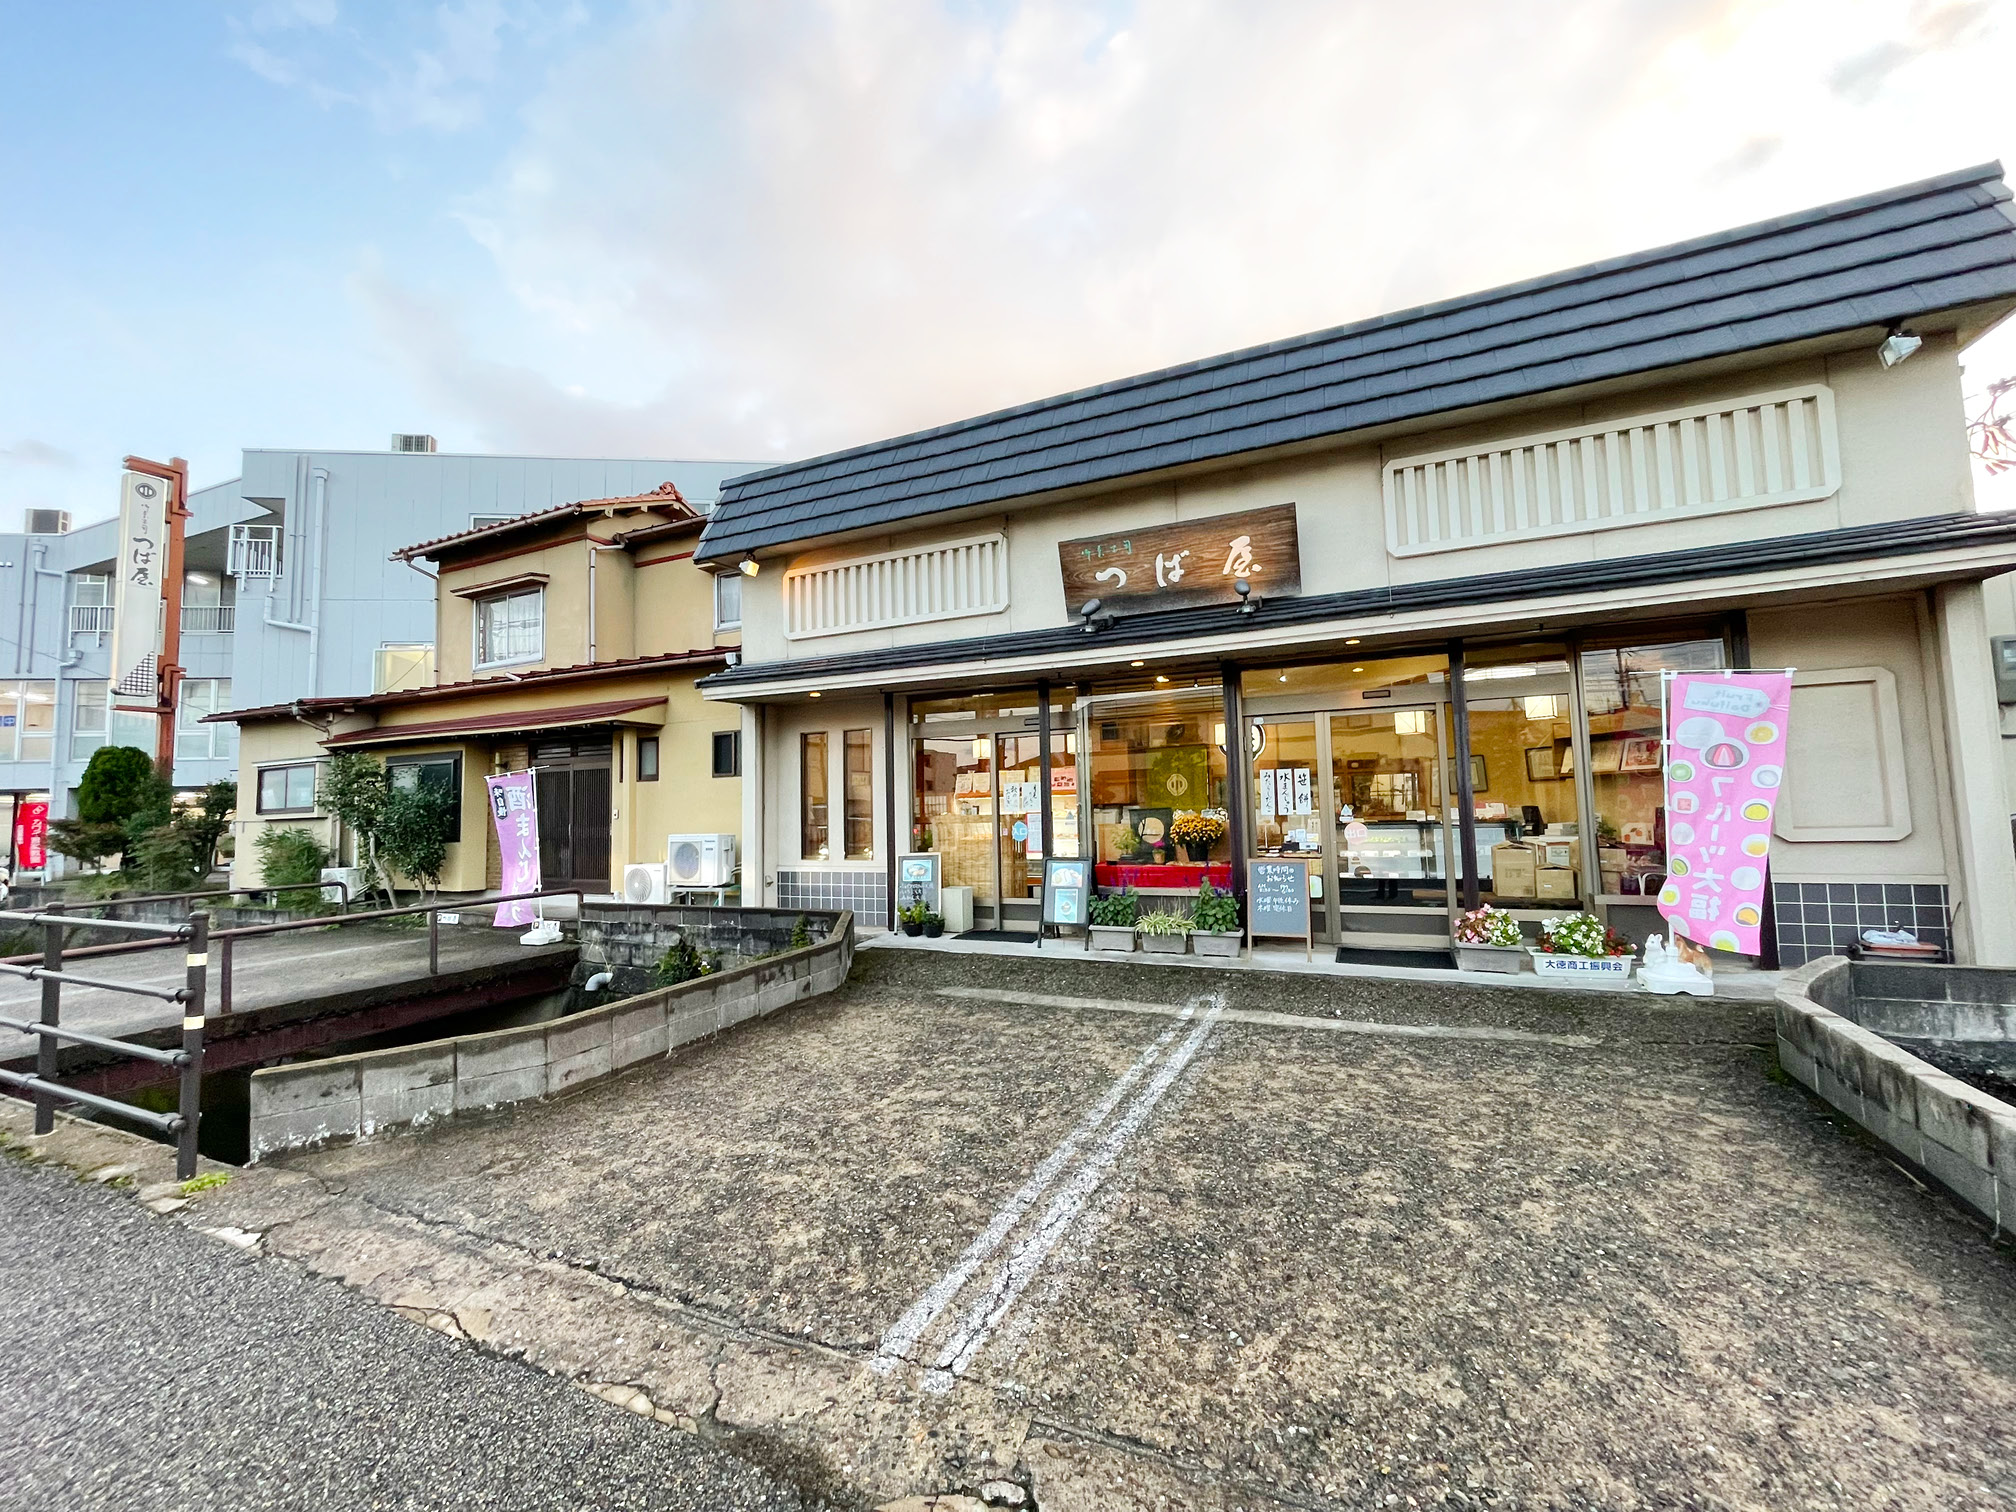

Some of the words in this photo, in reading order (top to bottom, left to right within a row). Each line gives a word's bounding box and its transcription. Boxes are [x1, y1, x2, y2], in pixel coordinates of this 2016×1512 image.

[131, 536, 157, 586] つば屋
[1095, 535, 1262, 589] つば屋
[1279, 772, 1290, 813] 水まんじゅう
[1013, 828, 1028, 836] 入口
[1545, 959, 1623, 971] 大徳商工振興会
